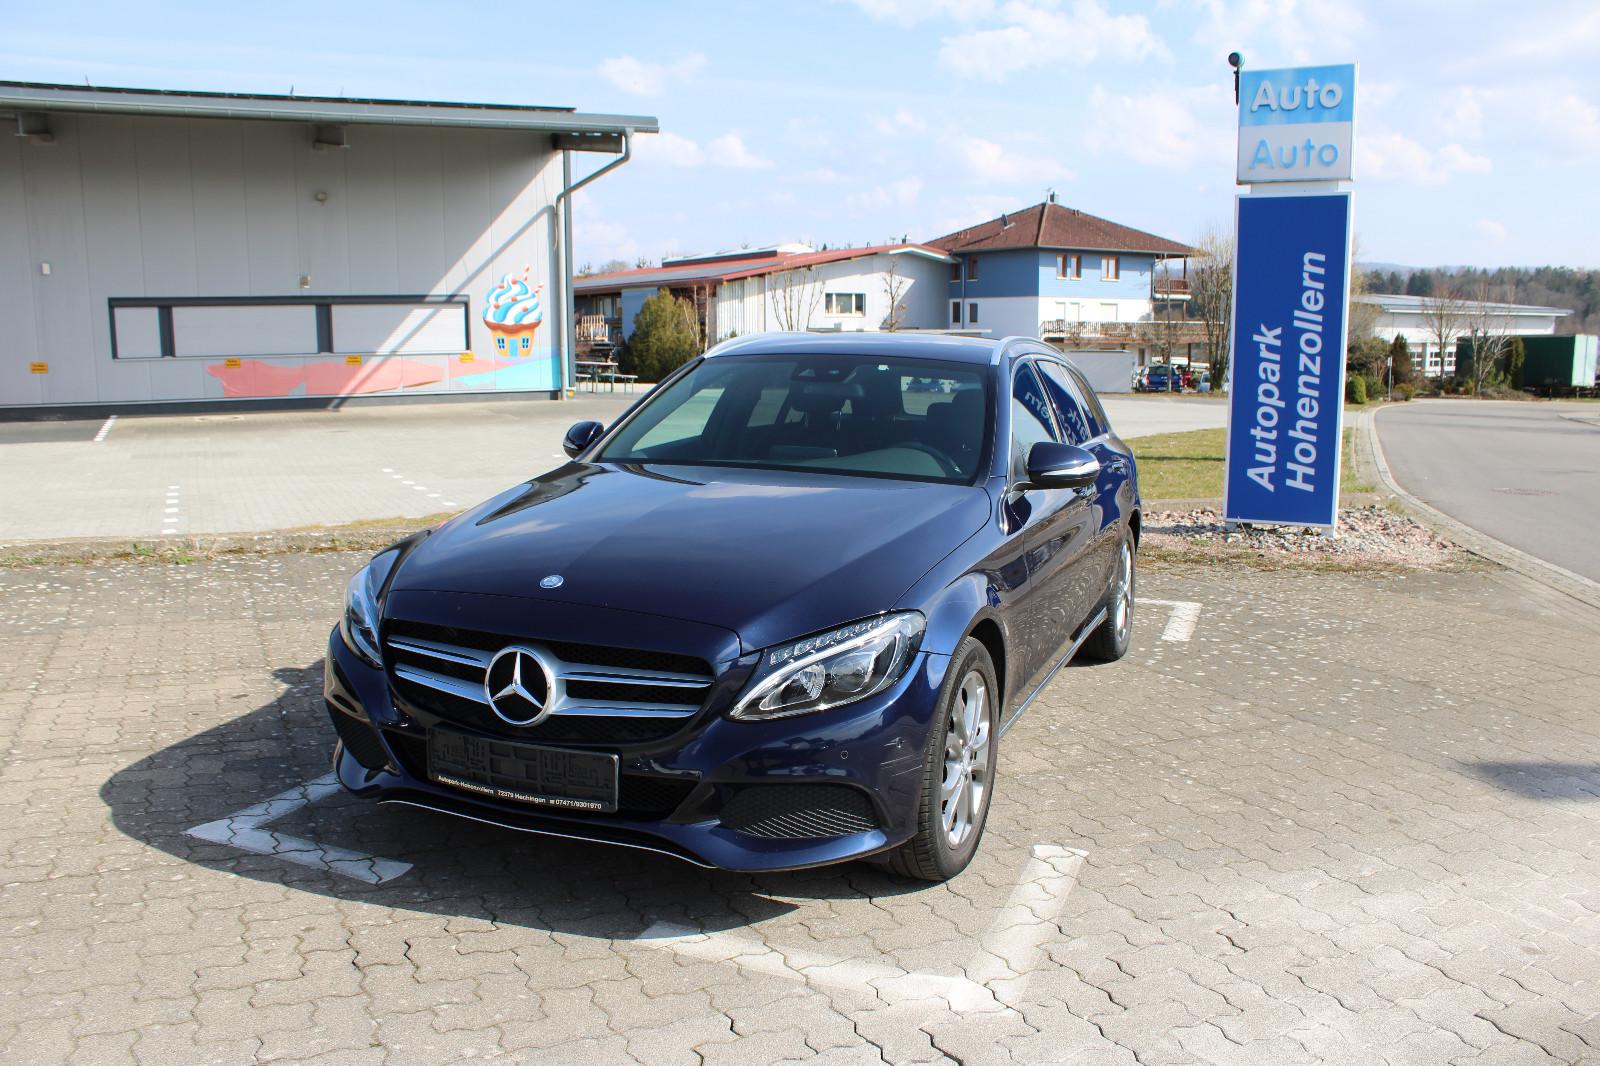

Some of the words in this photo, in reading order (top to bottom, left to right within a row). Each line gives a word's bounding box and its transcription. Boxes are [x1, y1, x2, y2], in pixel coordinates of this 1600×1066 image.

[1250, 78, 1343, 112] Auto
[1249, 138, 1338, 168] Auto
[1246, 324, 1285, 493] Autopark
[1286, 251, 1326, 493] Hohenzollern
